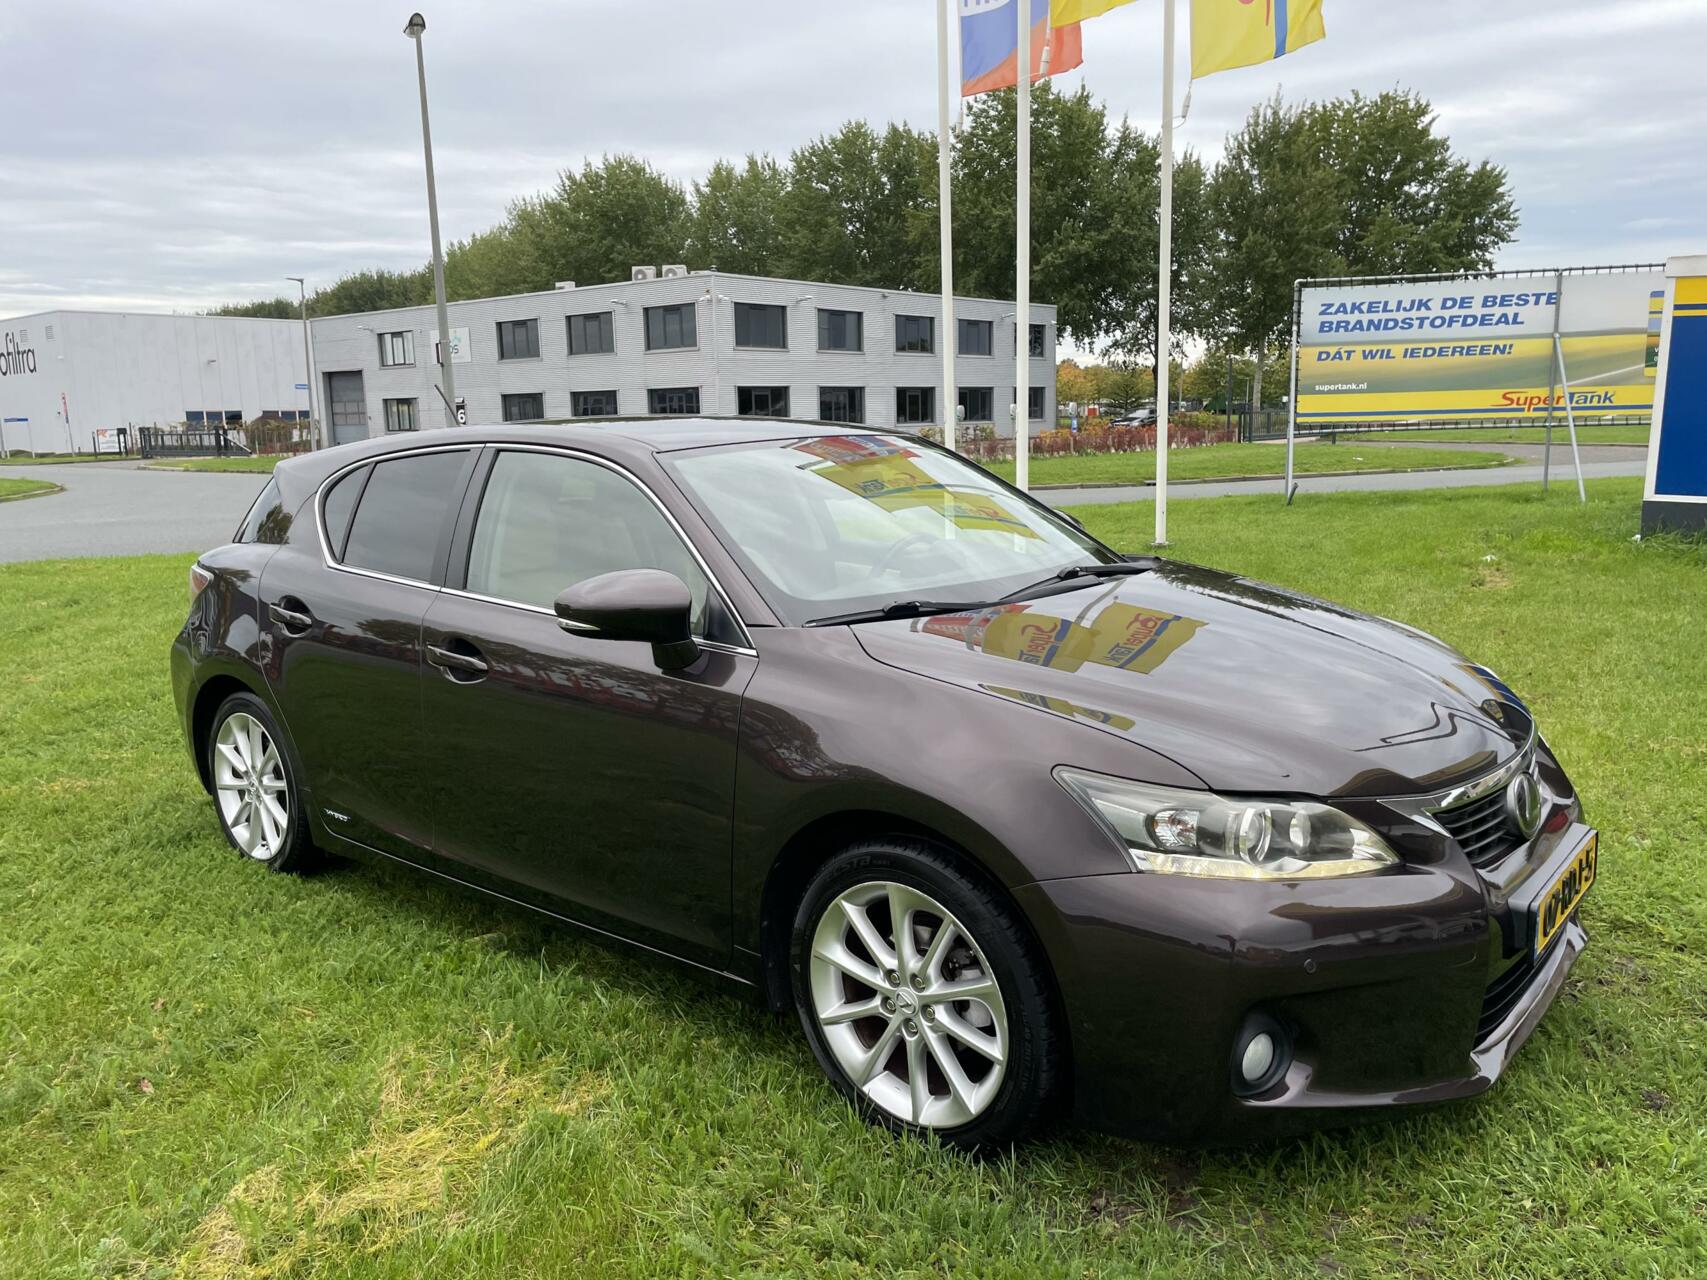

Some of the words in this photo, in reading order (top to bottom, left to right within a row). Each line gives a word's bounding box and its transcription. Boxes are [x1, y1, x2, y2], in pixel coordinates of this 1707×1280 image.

[1318, 297, 1433, 316] ZAKELIJK
[1440, 296, 1474, 311] DE
[1481, 291, 1558, 308] BESTE
[1318, 312, 1525, 334] BRANDSTOFDEAL
[1316, 347, 1355, 362] DÁT
[1361, 347, 1396, 360] WIL
[1402, 343, 1514, 359] IEDEREEN!
[1314, 382, 1367, 392] supertank.nl
